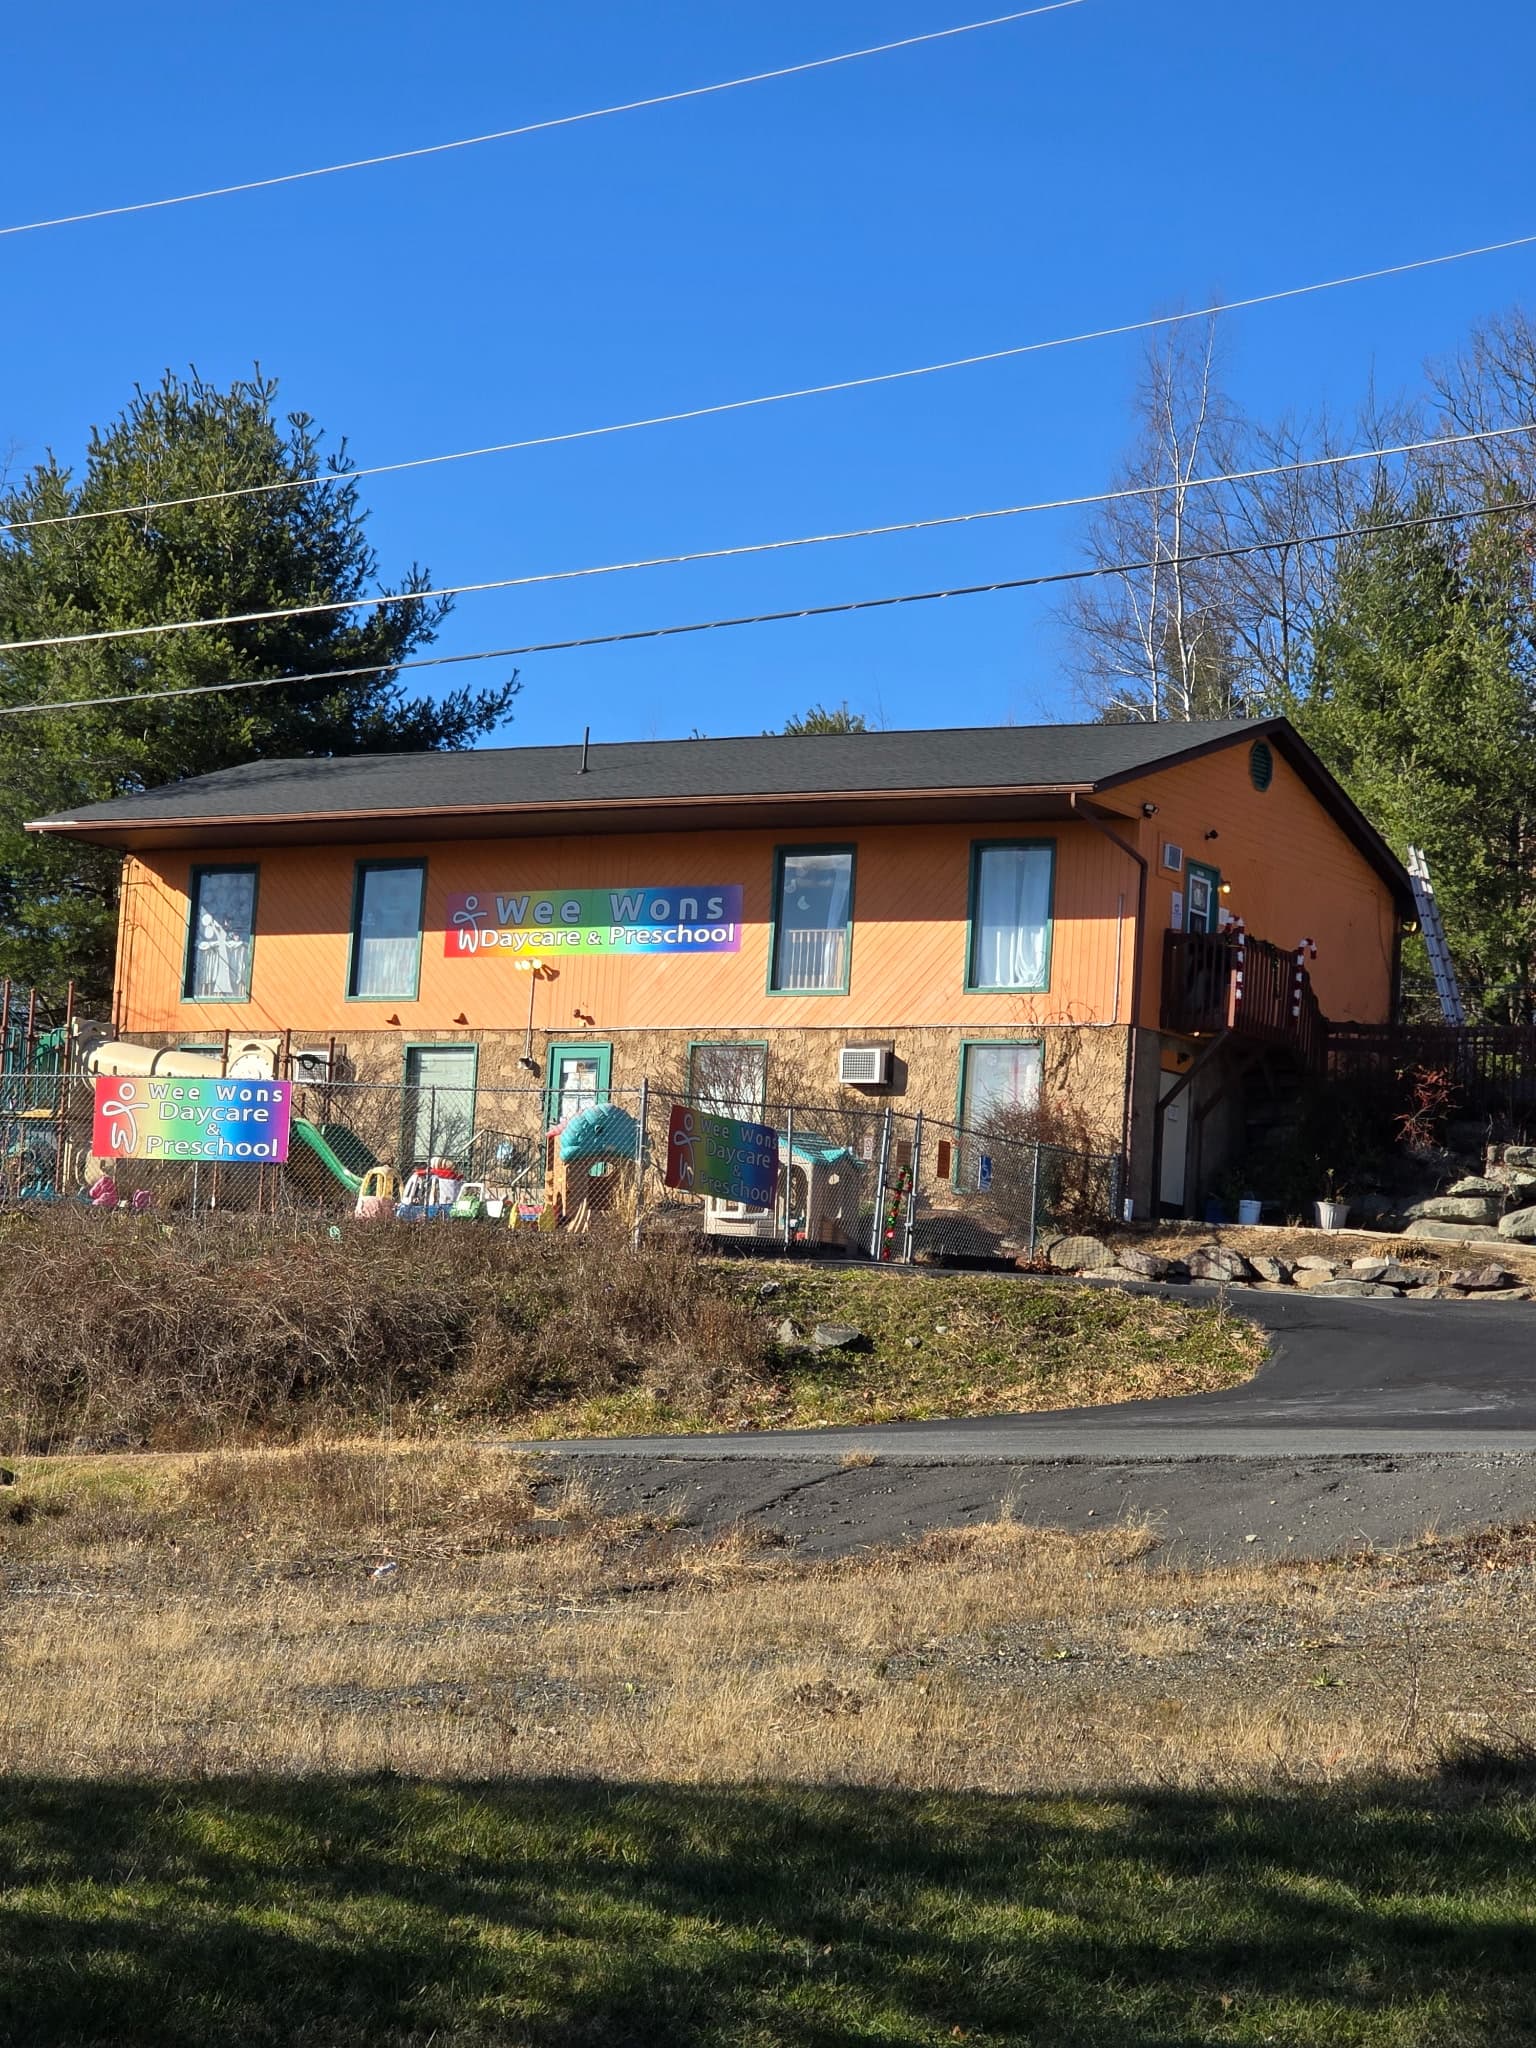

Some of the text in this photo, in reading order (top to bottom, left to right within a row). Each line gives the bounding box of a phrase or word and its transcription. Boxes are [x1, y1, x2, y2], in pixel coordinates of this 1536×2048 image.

[496, 893, 724, 925] Wee Wons
[480, 923, 736, 952] Daycare & Preschool
[148, 1083, 283, 1102] Wee Wons
[159, 1102, 269, 1125] Daycare
[206, 1123, 221, 1136] &
[701, 1119, 777, 1149] Wee Wons
[146, 1136, 278, 1157] Preschool
[705, 1138, 770, 1168] Daycare
[732, 1164, 742, 1177] &
[701, 1172, 773, 1204] Preschool
